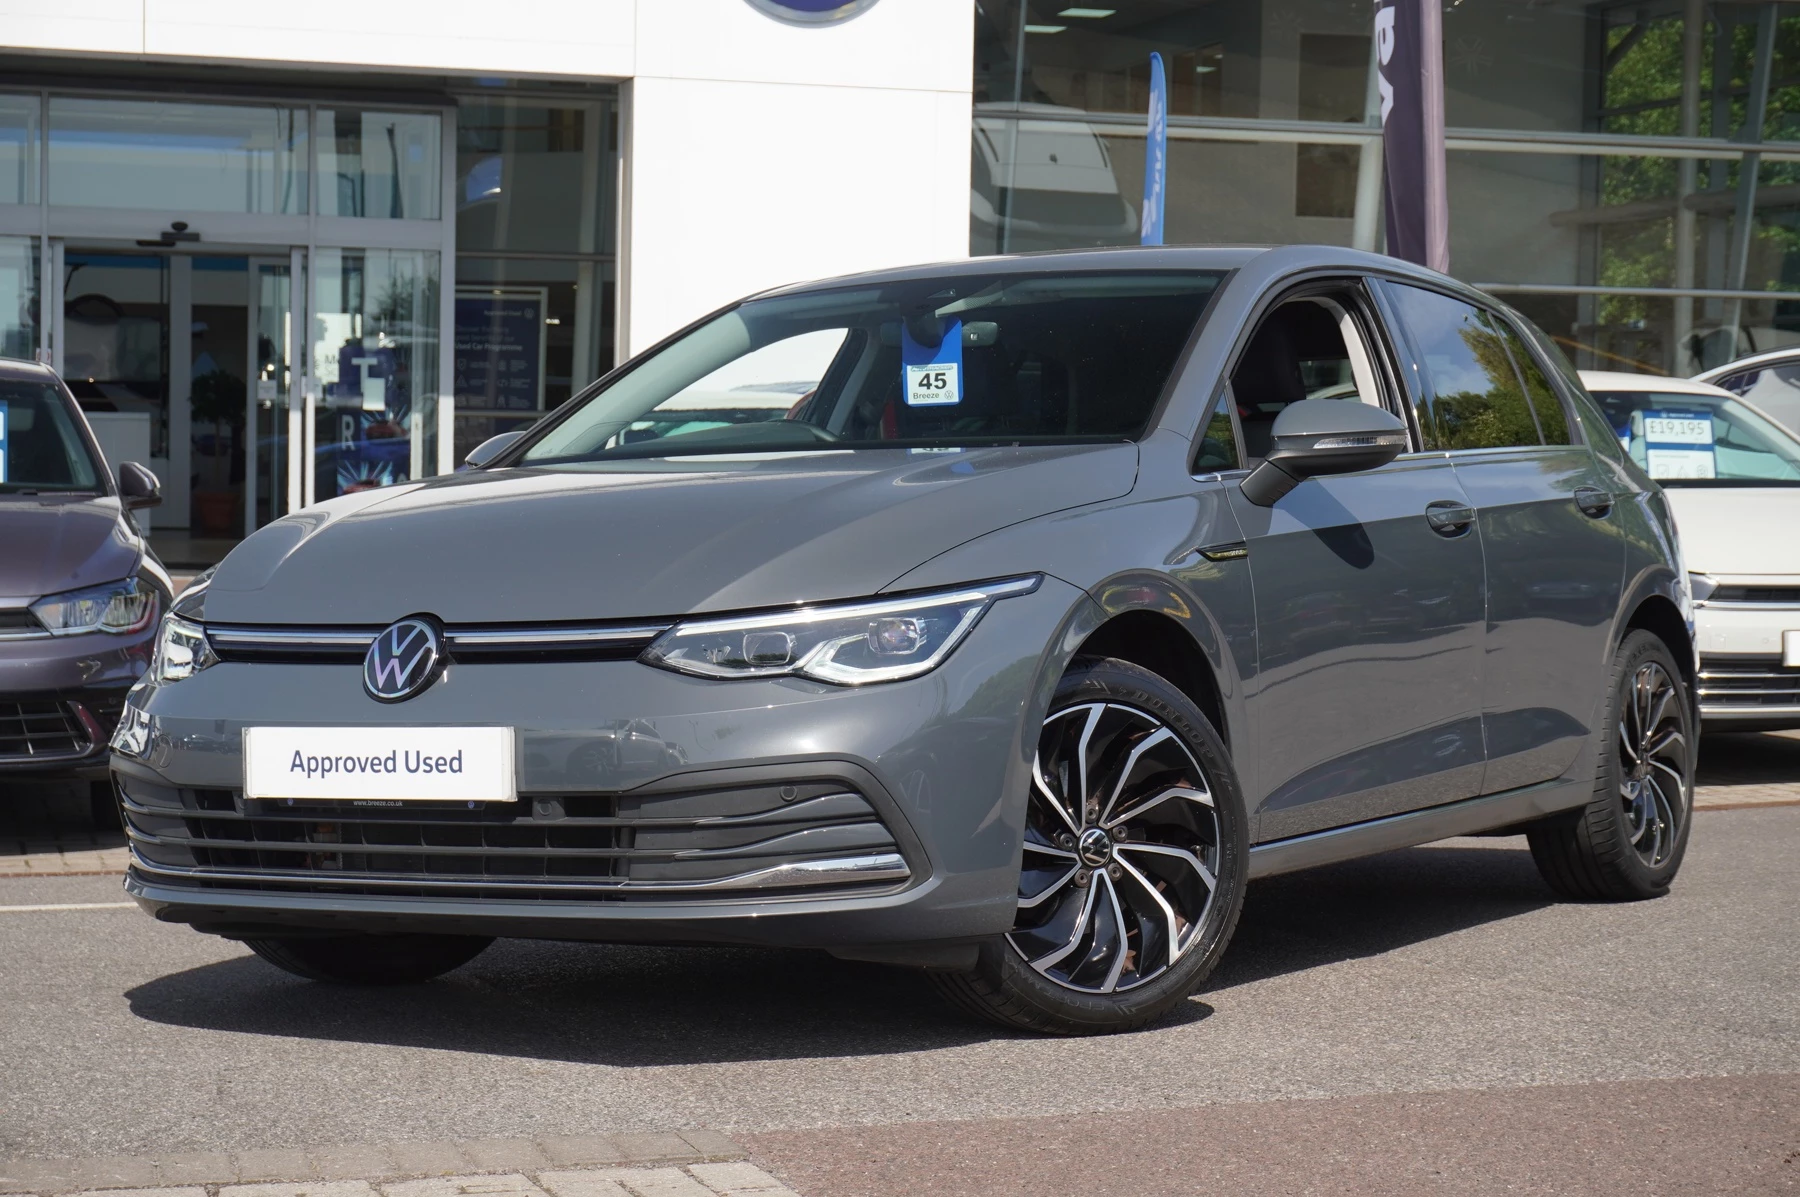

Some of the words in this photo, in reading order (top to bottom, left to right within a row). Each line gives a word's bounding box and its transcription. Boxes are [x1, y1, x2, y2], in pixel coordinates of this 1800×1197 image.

[918, 372, 947, 390] 45
[913, 392, 940, 400] Breeze
[1649, 420, 1705, 436] £19,195
[1133, 690, 1214, 758] DUNLOP
[290, 749, 397, 779] Approved
[404, 749, 463, 774] Used
[353, 799, 403, 807] www.breeze.co.uk
